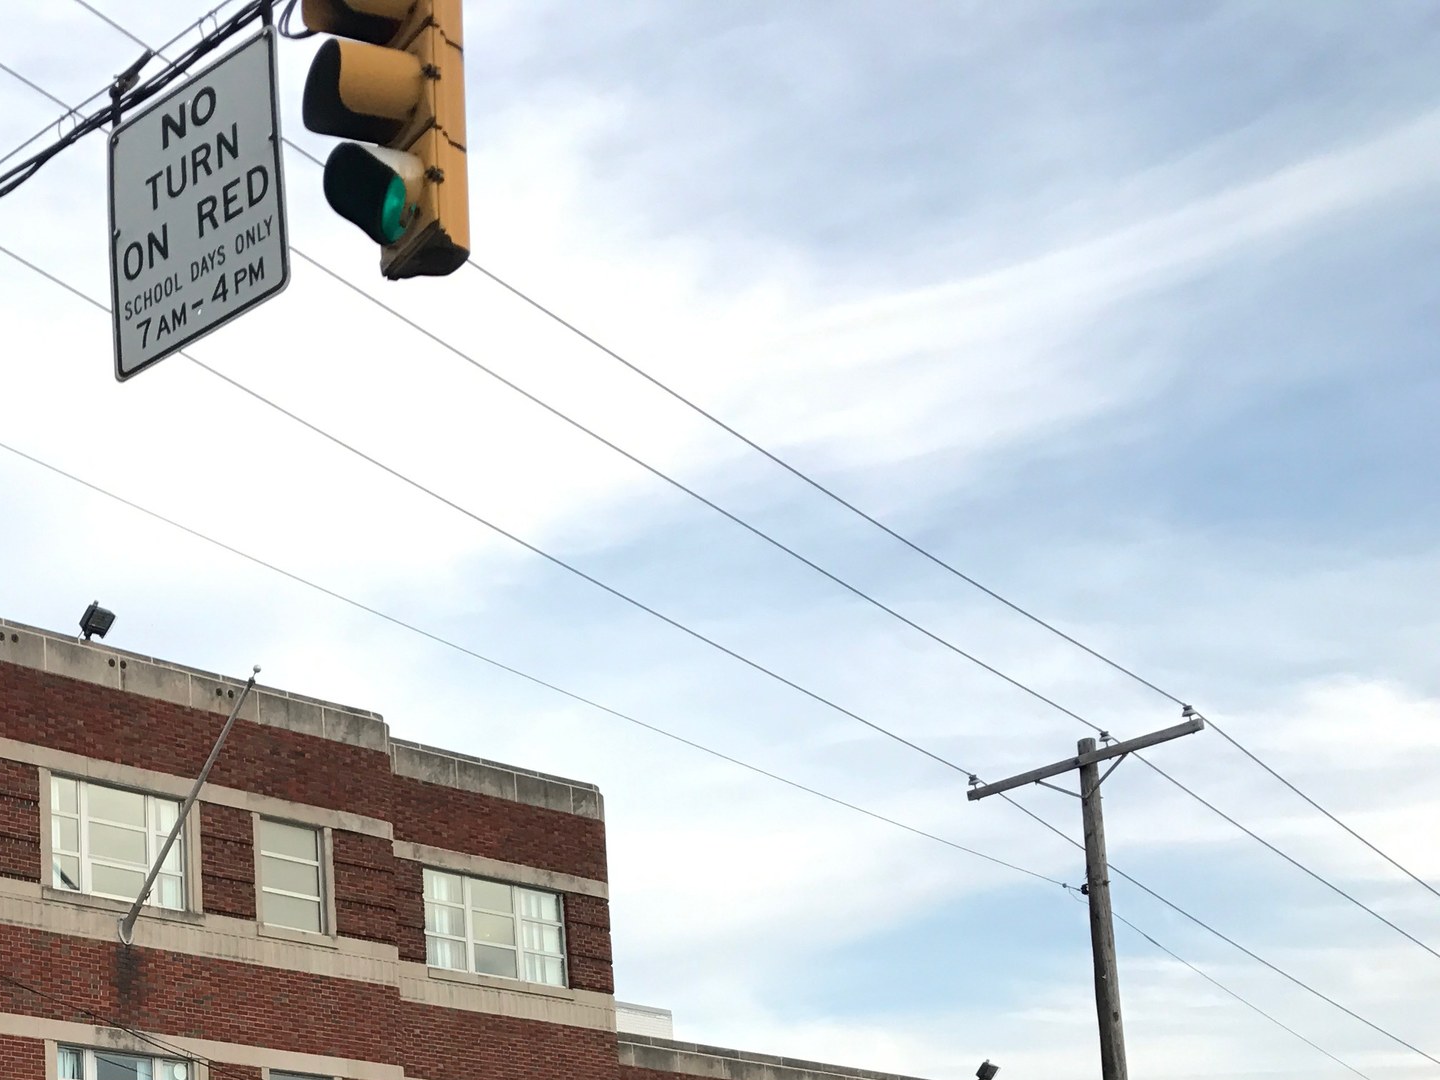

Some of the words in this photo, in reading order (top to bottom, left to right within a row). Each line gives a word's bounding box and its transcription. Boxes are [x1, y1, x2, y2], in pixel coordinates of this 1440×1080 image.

[162, 86, 216, 150] NO
[145, 123, 239, 211] TURN
[123, 224, 169, 281] ON
[198, 166, 269, 239] RED
[125, 276, 182, 320] SCHOOL
[190, 245, 226, 283] DAYS
[235, 215, 273, 255] ONLY
